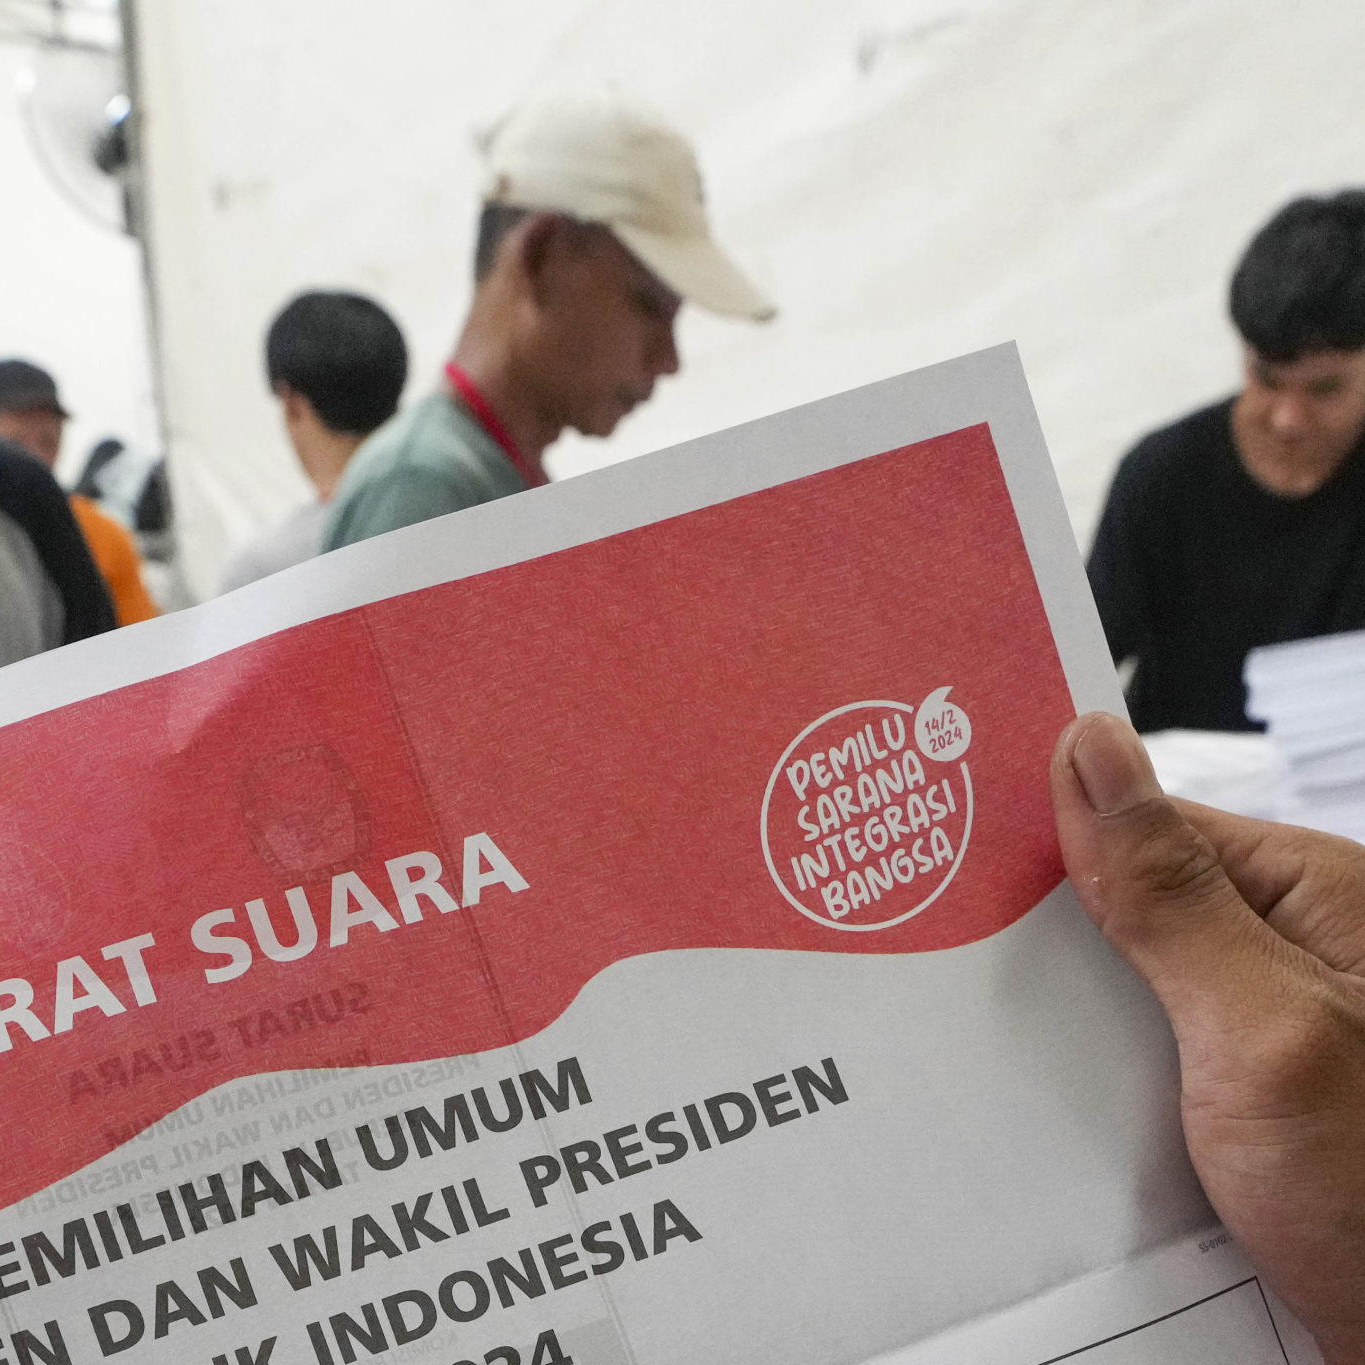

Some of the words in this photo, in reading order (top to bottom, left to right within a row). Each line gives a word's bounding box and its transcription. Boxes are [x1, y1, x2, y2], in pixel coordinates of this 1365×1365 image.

[785, 713, 906, 802] PEMILU
[925, 709, 957, 736] 14/2
[929, 726, 963, 754] 2024
[790, 778, 957, 892] INTEGRASI
[797, 750, 926, 842] SARANA
[193, 831, 530, 986] SUARA
[820, 826, 955, 920] BANGSA
[357, 1057, 593, 1173] UMUM
[87, 1255, 261, 1358] DAN
[267, 1176, 511, 1293] WAKIL
[519, 1056, 851, 1211] PRESIDEN
